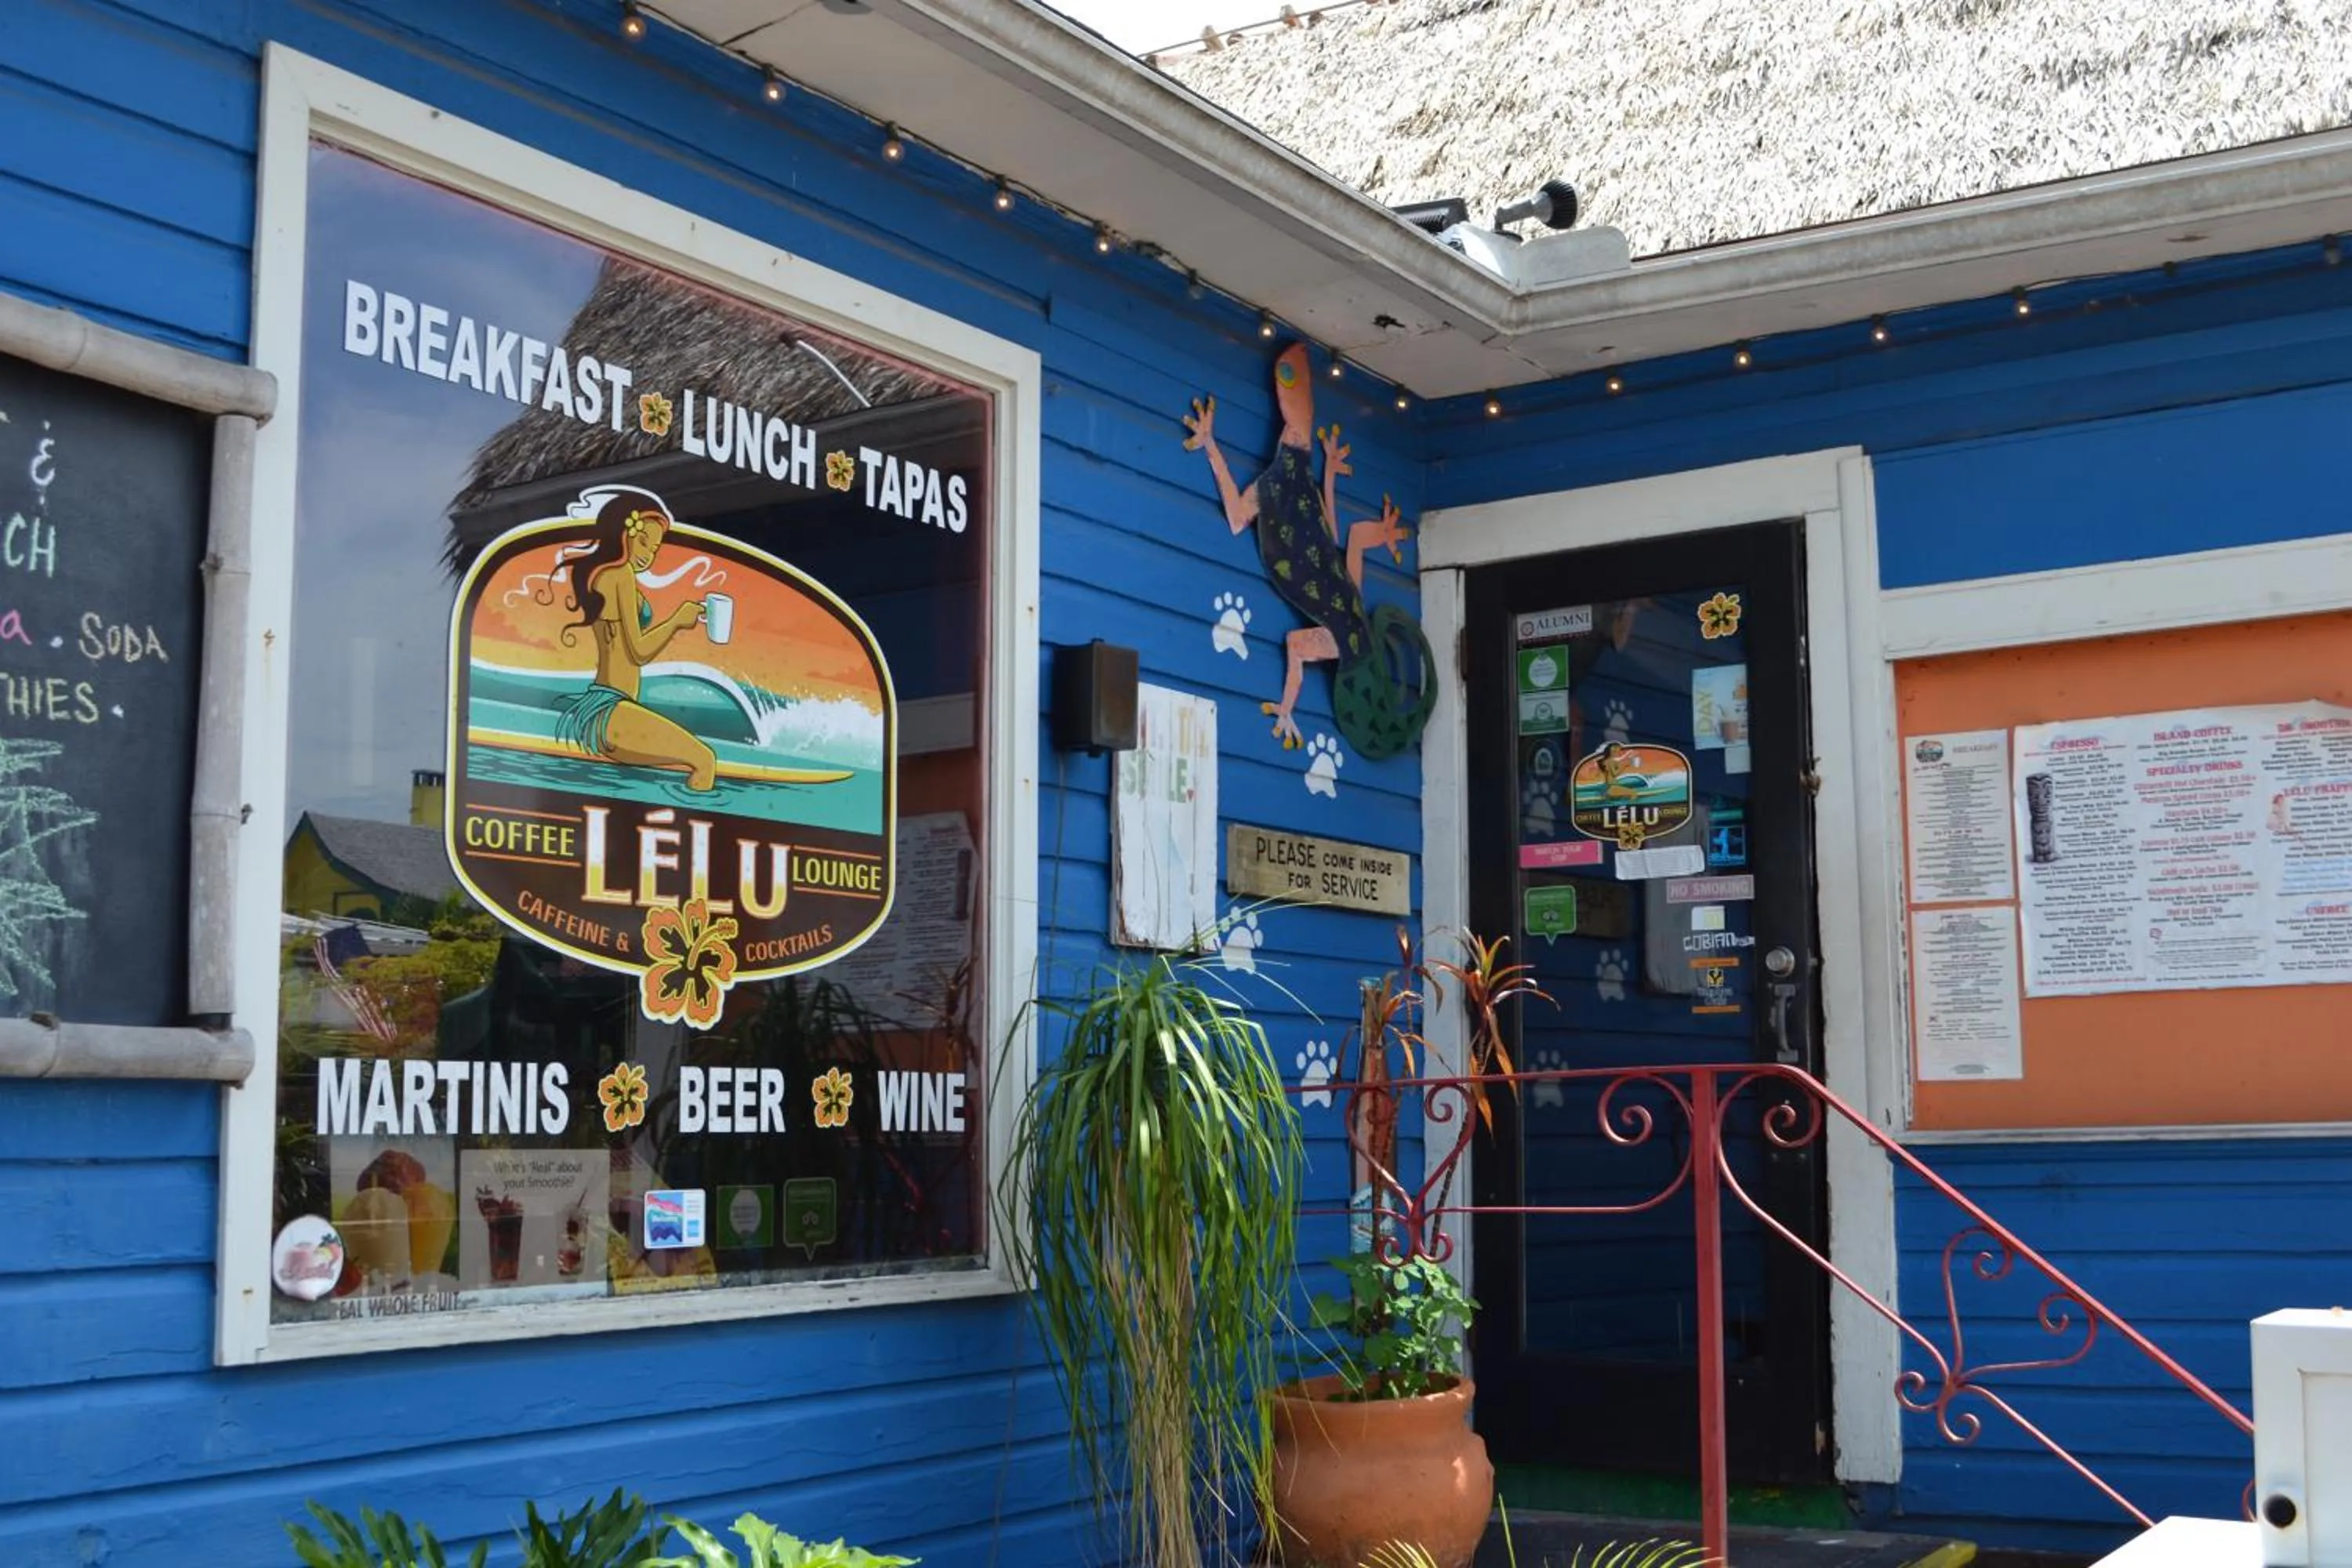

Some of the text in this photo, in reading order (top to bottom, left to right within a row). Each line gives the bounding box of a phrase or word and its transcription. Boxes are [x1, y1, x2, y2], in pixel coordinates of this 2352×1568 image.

[343, 279, 967, 533] BREAKFAST LUNCH TAPAS
[1537, 612, 1590, 630] ALUMNI
[79, 612, 169, 663] SODA
[465, 817, 575, 857] COFFEE
[793, 855, 882, 891] LOUNGE
[1256, 837, 1392, 876] PLEASE COME INSIDE
[1288, 873, 1378, 901] FOR SERVICE
[1670, 880, 1748, 898] NO SMOKING
[517, 890, 833, 963] CAFFEINE & COCKTAILS
[1683, 932, 1735, 951] COBIAN
[316, 1058, 965, 1134] MARTINIS BEER WINE
[556, 1160, 583, 1174] about
[503, 1178, 525, 1191] your
[336, 1291, 460, 1319] EAL WHOLE FRUIT
